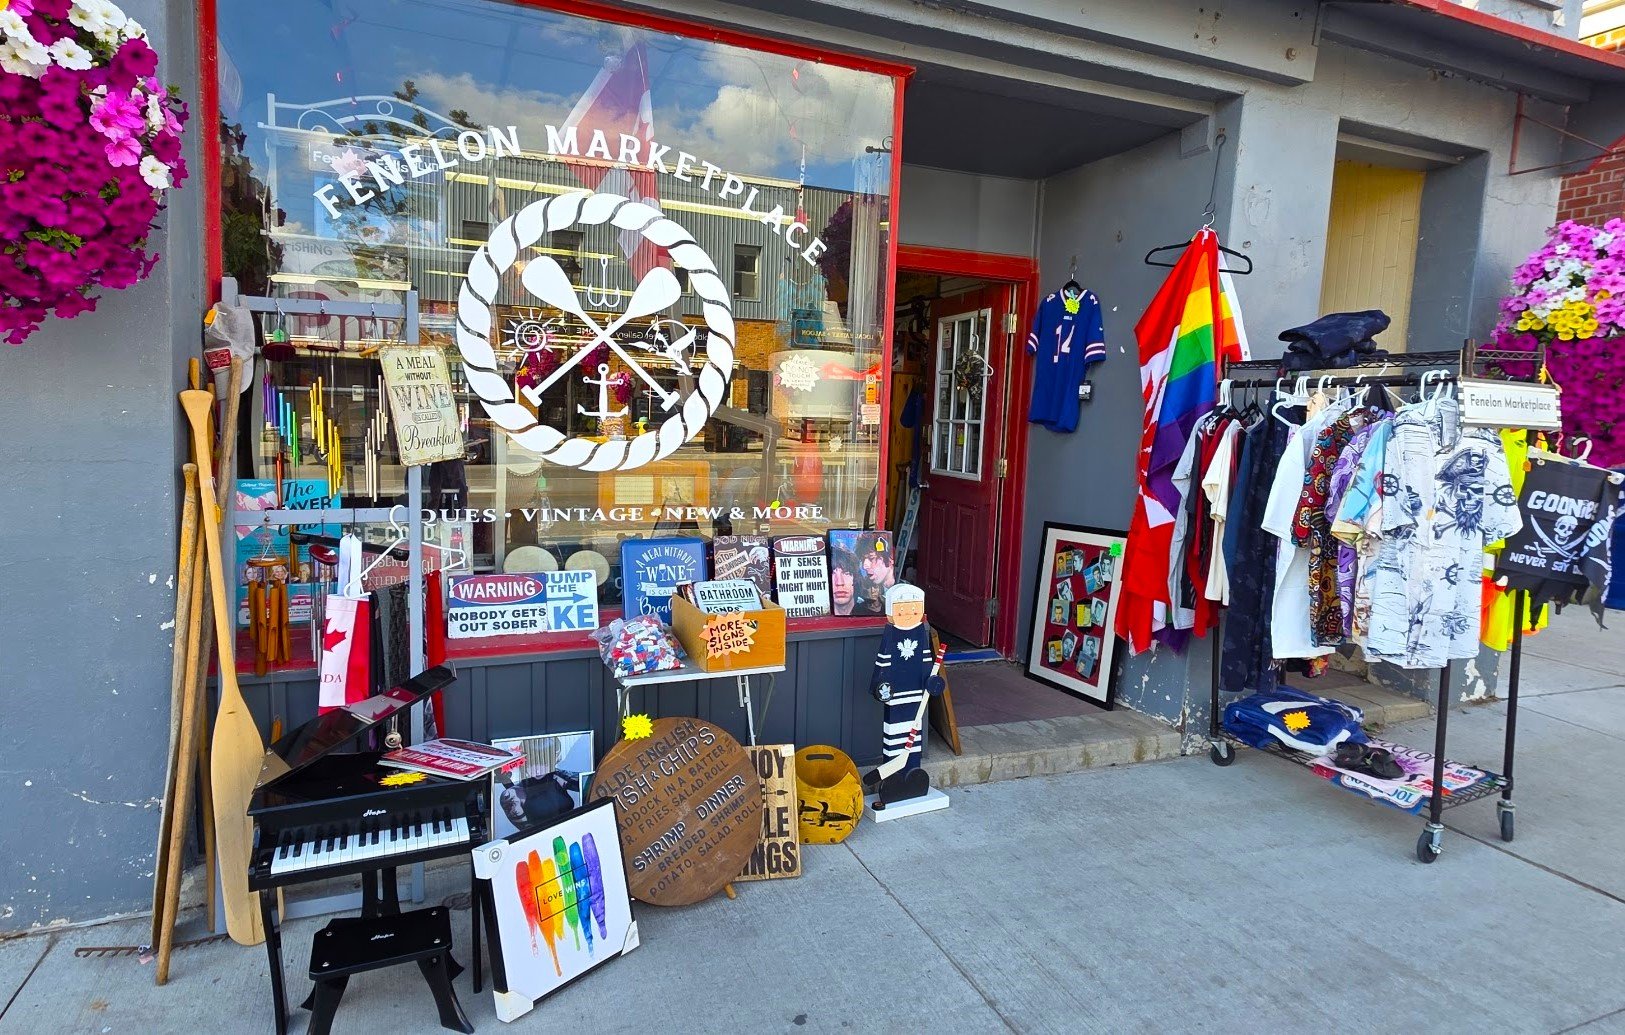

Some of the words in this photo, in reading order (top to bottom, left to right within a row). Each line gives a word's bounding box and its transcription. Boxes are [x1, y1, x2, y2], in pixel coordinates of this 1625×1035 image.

[313, 125, 521, 220] FENELON
[545, 124, 827, 267] MARKETPLACE
[396, 357, 404, 370] A
[405, 356, 435, 369] MEAL
[405, 372, 432, 380] WITHOUT
[391, 384, 451, 411] WINE
[1470, 394, 1502, 408] Fenelon
[1504, 396, 1551, 412] Marketplace
[421, 412, 440, 420] CALLED
[402, 424, 457, 456] Breakfast
[282, 481, 316, 501] The
[520, 508, 644, 521] VINTAGE
[664, 506, 723, 521] NEW
[730, 505, 746, 521] &
[752, 506, 824, 521] MORE
[385, 525, 435, 541] COD
[781, 538, 818, 551] WARNING
[635, 560, 645, 568] A
[642, 546, 662, 562] MEAL
[664, 546, 697, 566] WITHOUT
[780, 557, 791, 568] MY
[797, 556, 821, 567] SENSE
[781, 570, 791, 580] OF
[793, 569, 823, 579] HUMOR
[459, 581, 536, 599] WARNING
[548, 584, 577, 593] THE
[700, 587, 754, 600] BATHROOM
[779, 583, 803, 593] MIGHT
[806, 581, 826, 591] HURT
[636, 595, 672, 615] Brea
[793, 594, 814, 604] YOUR
[449, 610, 507, 622] NOBODY
[512, 608, 547, 618] GETS
[549, 604, 595, 630] KE
[786, 607, 824, 617] FEELINGS!
[459, 623, 488, 632] OUT
[493, 619, 538, 630] SOBER
[710, 620, 742, 636] MORE
[713, 638, 749, 654] INSIDE
[596, 763, 637, 799] OLDE
[638, 719, 698, 773] ENGLISH
[614, 774, 654, 811] ISH
[651, 770, 660, 782] &
[658, 726, 716, 777] CHIPS
[619, 796, 661, 832] ADDOCK
[664, 783, 677, 796] IN
[677, 777, 687, 788] A
[688, 744, 725, 776] BATTER
[638, 806, 674, 834] FRIES.
[704, 761, 730, 786] ROLL
[735, 802, 762, 825] ROLL
[632, 821, 687, 872] SHRIMP
[695, 774, 747, 821] DINNER
[657, 830, 707, 873] BREADED
[710, 794, 748, 828] SHRIMP
[743, 841, 797, 876] INGS
[542, 890, 563, 905] LOVE
[565, 879, 587, 894] WINS
